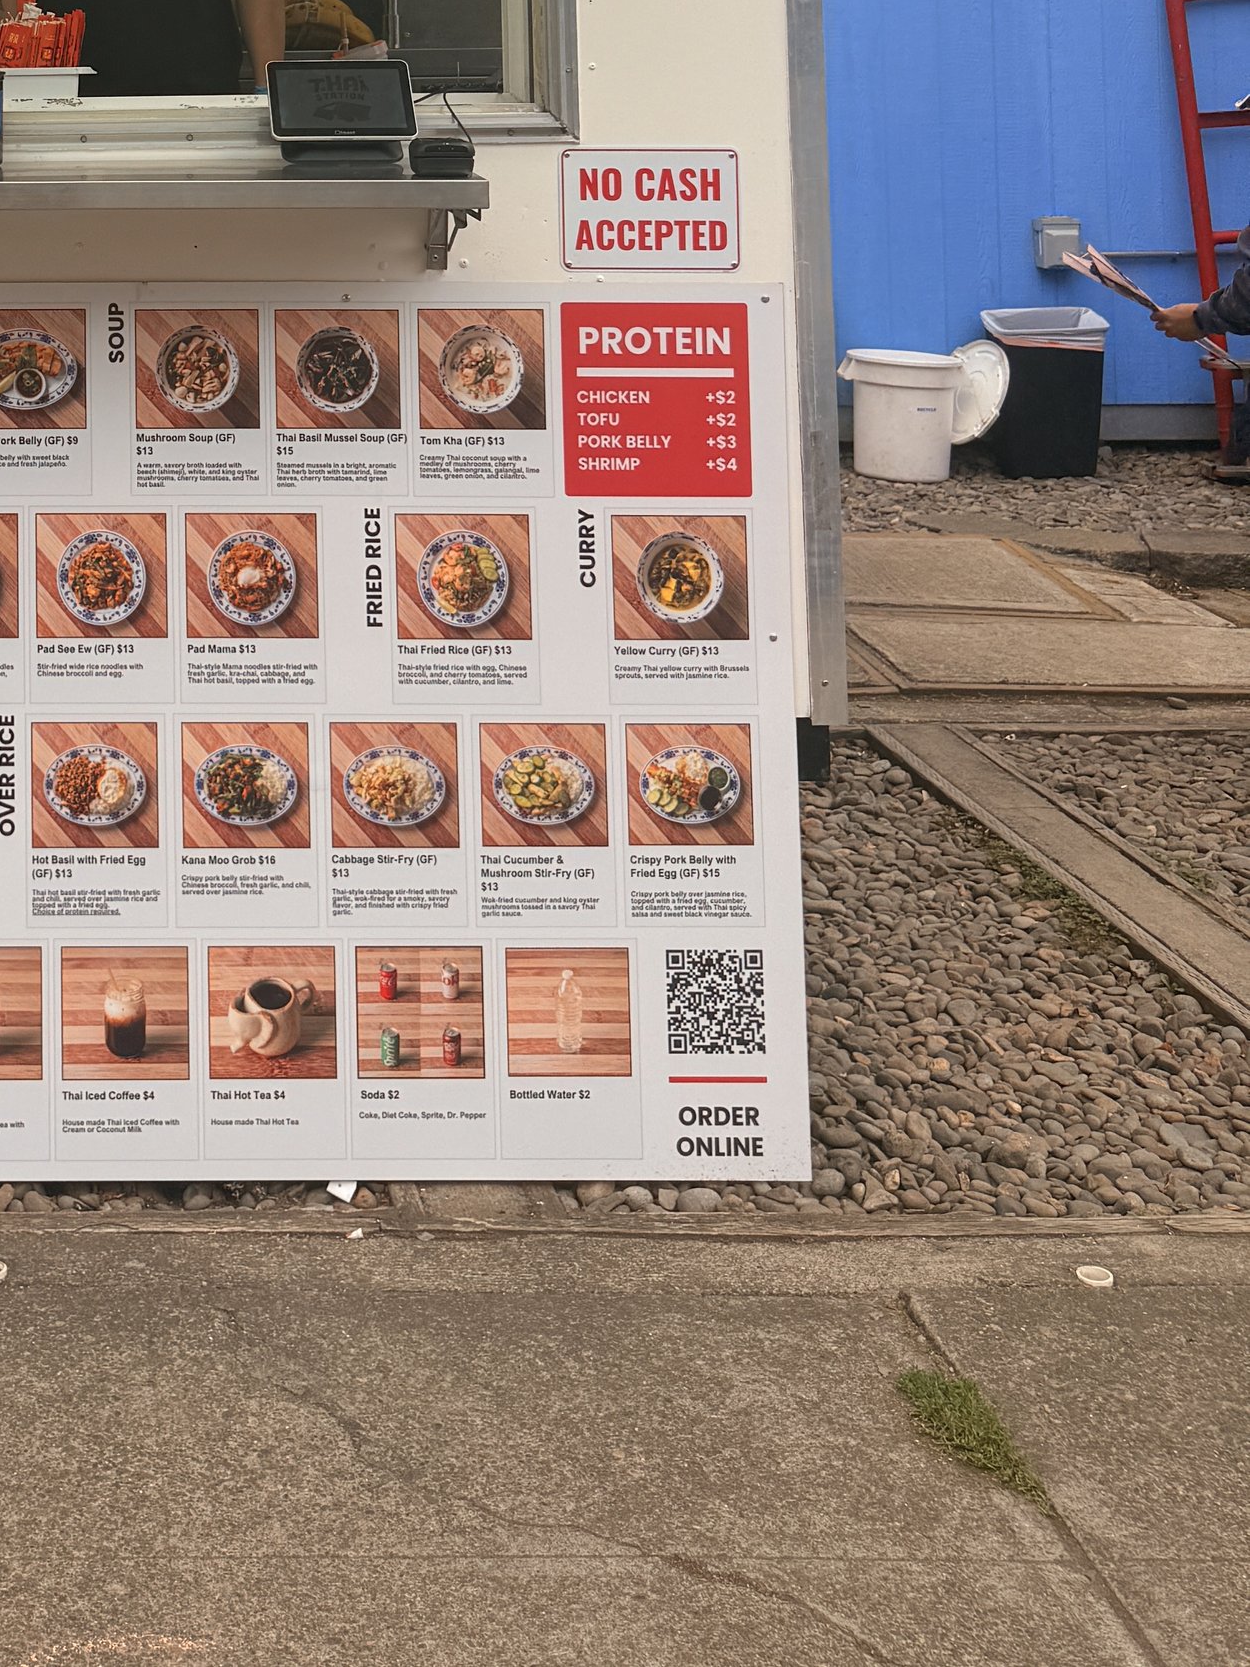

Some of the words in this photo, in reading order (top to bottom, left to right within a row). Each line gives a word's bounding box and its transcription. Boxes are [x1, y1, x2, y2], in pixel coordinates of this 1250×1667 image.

[580, 168, 621, 201] NO
[635, 168, 720, 201] CASH
[576, 220, 727, 250] ACCEPTED
[108, 303, 124, 362] SOUP
[579, 327, 730, 354] PROTEIN
[577, 391, 649, 403] CHICKEN
[706, 390, 735, 404] +$2
[577, 413, 619, 425] TOFU
[707, 413, 736, 427] +$2
[135, 433, 187, 441] Mushroom
[187, 433, 214, 443] Soup
[214, 433, 236, 443] (GF)
[419, 436, 441, 444] Tom
[442, 436, 462, 444] Kha
[463, 436, 485, 446] (GF)
[486, 436, 505, 445] $13
[577, 435, 620, 449] PORK
[625, 435, 672, 449] BELLY
[707, 435, 736, 449] +$3
[135, 446, 154, 455] $13
[579, 458, 640, 470] SHRIMP
[707, 458, 737, 471] +$4
[363, 507, 382, 559] RICE
[578, 509, 596, 587] CURRY
[365, 564, 383, 628] FRIED
[186, 644, 206, 653] Pad
[207, 644, 237, 653] Mama
[238, 644, 256, 653] $13
[613, 646, 647, 655] Yellow
[647, 646, 677, 657] Curry
[677, 646, 700, 657] (GF)
[700, 646, 719, 655] $13
[181, 855, 206, 864] Kana
[207, 855, 230, 864] Moo
[231, 855, 256, 864] Grob
[257, 855, 276, 864] $16
[359, 1090, 386, 1099] Soda
[387, 1090, 400, 1099] $2
[509, 1090, 545, 1098] Bottled
[545, 1090, 577, 1098] Water
[577, 1089, 591, 1099] $2
[357, 1111, 381, 1119] Coke,
[397, 1111, 420, 1119] Coke,
[420, 1111, 446, 1119] Sprite,
[459, 1111, 487, 1119] Pepper
[679, 1107, 759, 1126] ORDER
[677, 1137, 763, 1156] ONLINE
